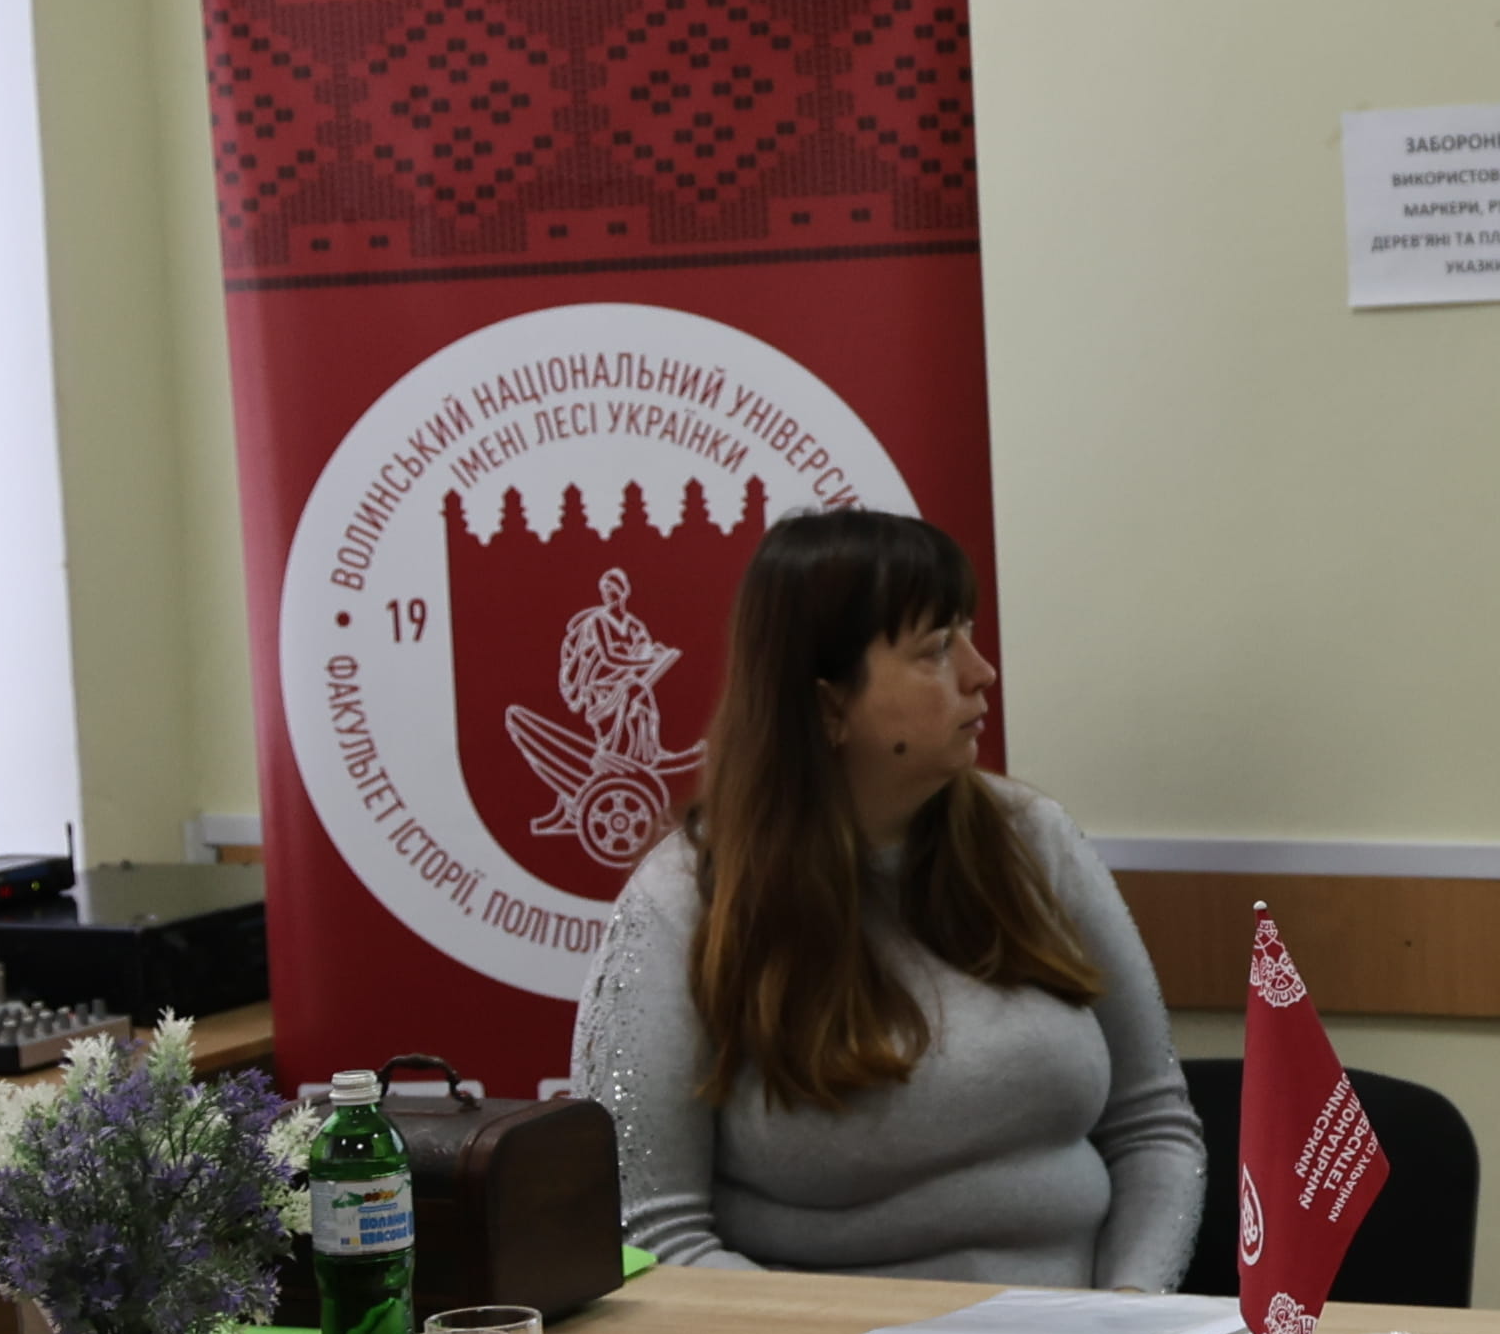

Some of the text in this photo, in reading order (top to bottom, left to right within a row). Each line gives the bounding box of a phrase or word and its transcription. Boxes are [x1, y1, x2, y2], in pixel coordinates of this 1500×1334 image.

[1404, 201, 1483, 218] МАРКЕРИ,
[1456, 232, 1474, 246] ТА
[330, 351, 863, 592] ВОЛИНСЬКИЙ НАЦІОНАЛЬНИЙ УНІВЕРСИ
[450, 401, 749, 489] ІМЕНІ ЛЕСІ УКРАЇНКИ
[386, 598, 427, 643] 19
[326, 655, 406, 823] ФАКУЛЬТЕТ
[388, 817, 486, 915] ІСТОРІЇ,
